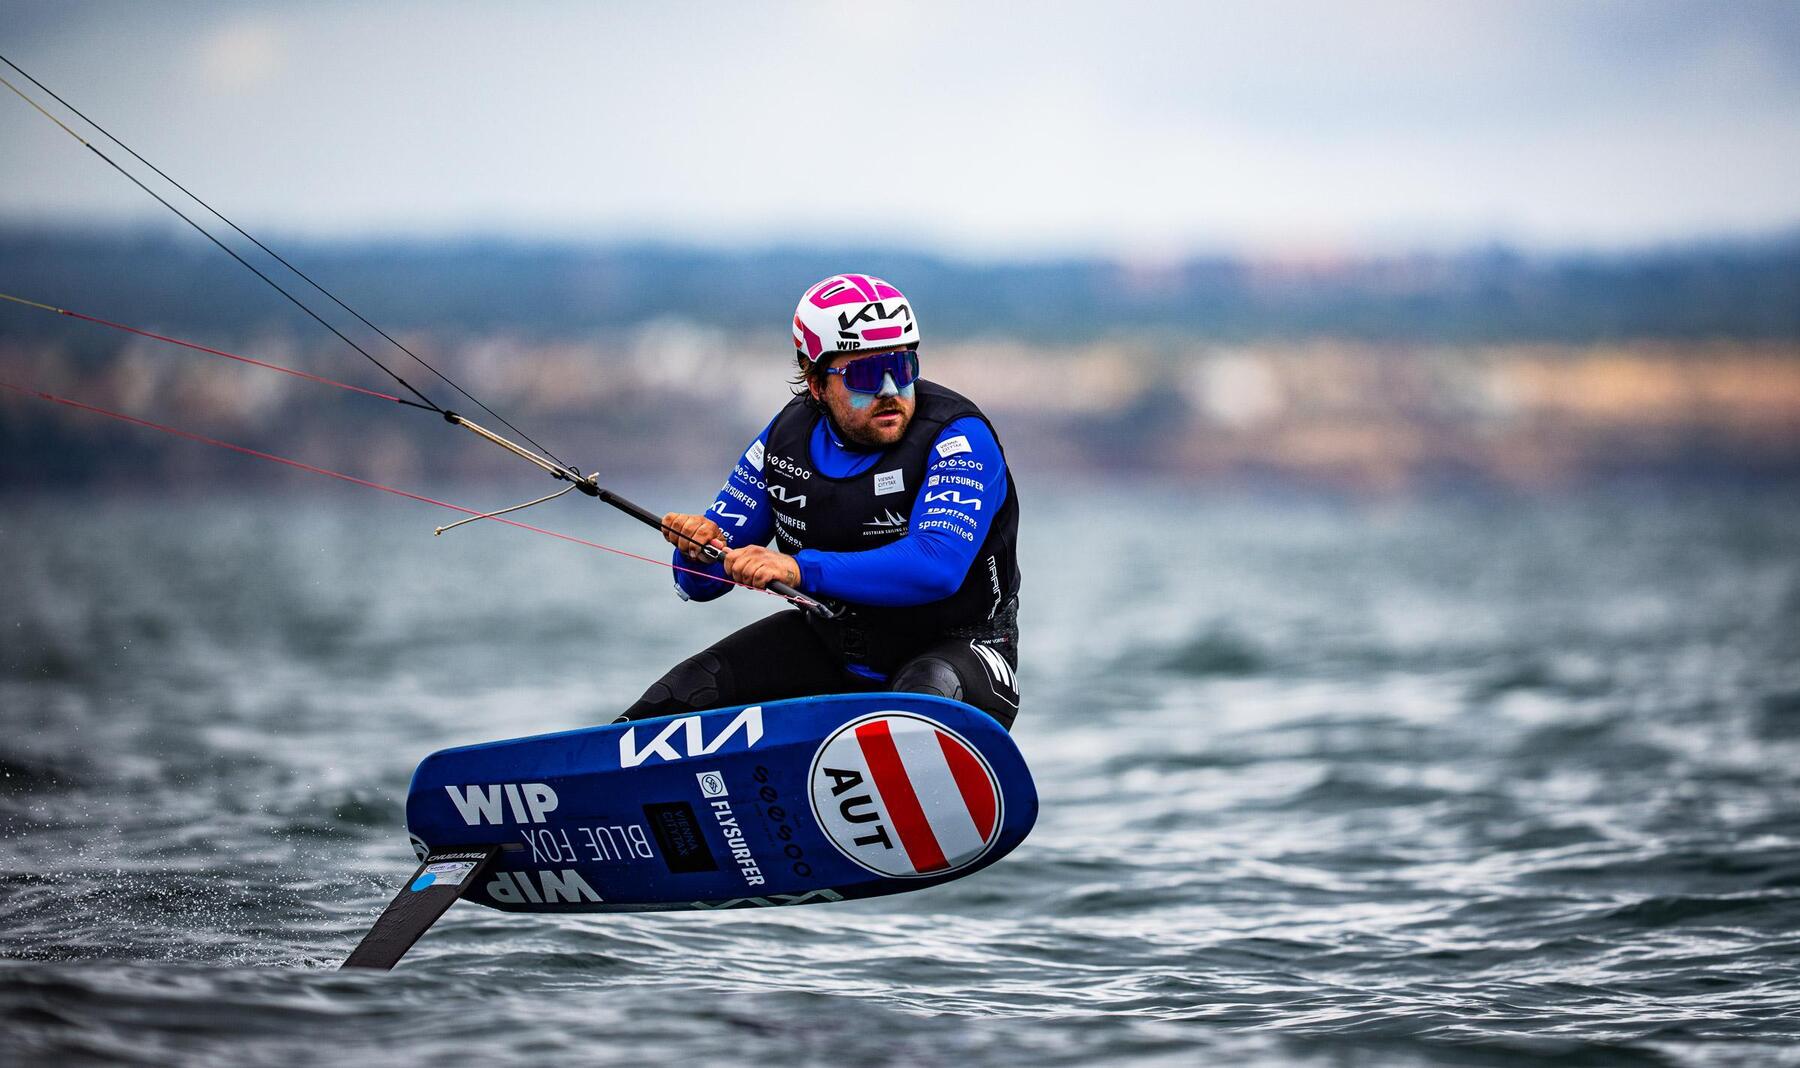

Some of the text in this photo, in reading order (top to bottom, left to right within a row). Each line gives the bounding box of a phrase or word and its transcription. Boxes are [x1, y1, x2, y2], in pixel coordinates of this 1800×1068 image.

[837, 302, 911, 331] KIA
[836, 341, 860, 350] WIP
[941, 475, 984, 492] FLYSURFER
[918, 520, 967, 539] sporthilfe
[619, 706, 764, 769] KIA
[445, 783, 559, 826] WIP
[752, 765, 812, 877] seesoo
[822, 767, 894, 850] AUT
[520, 827, 578, 864] FOX
[578, 825, 654, 861] BLUE
[710, 800, 765, 886] FLYSURFER
[486, 869, 604, 904] WIP
